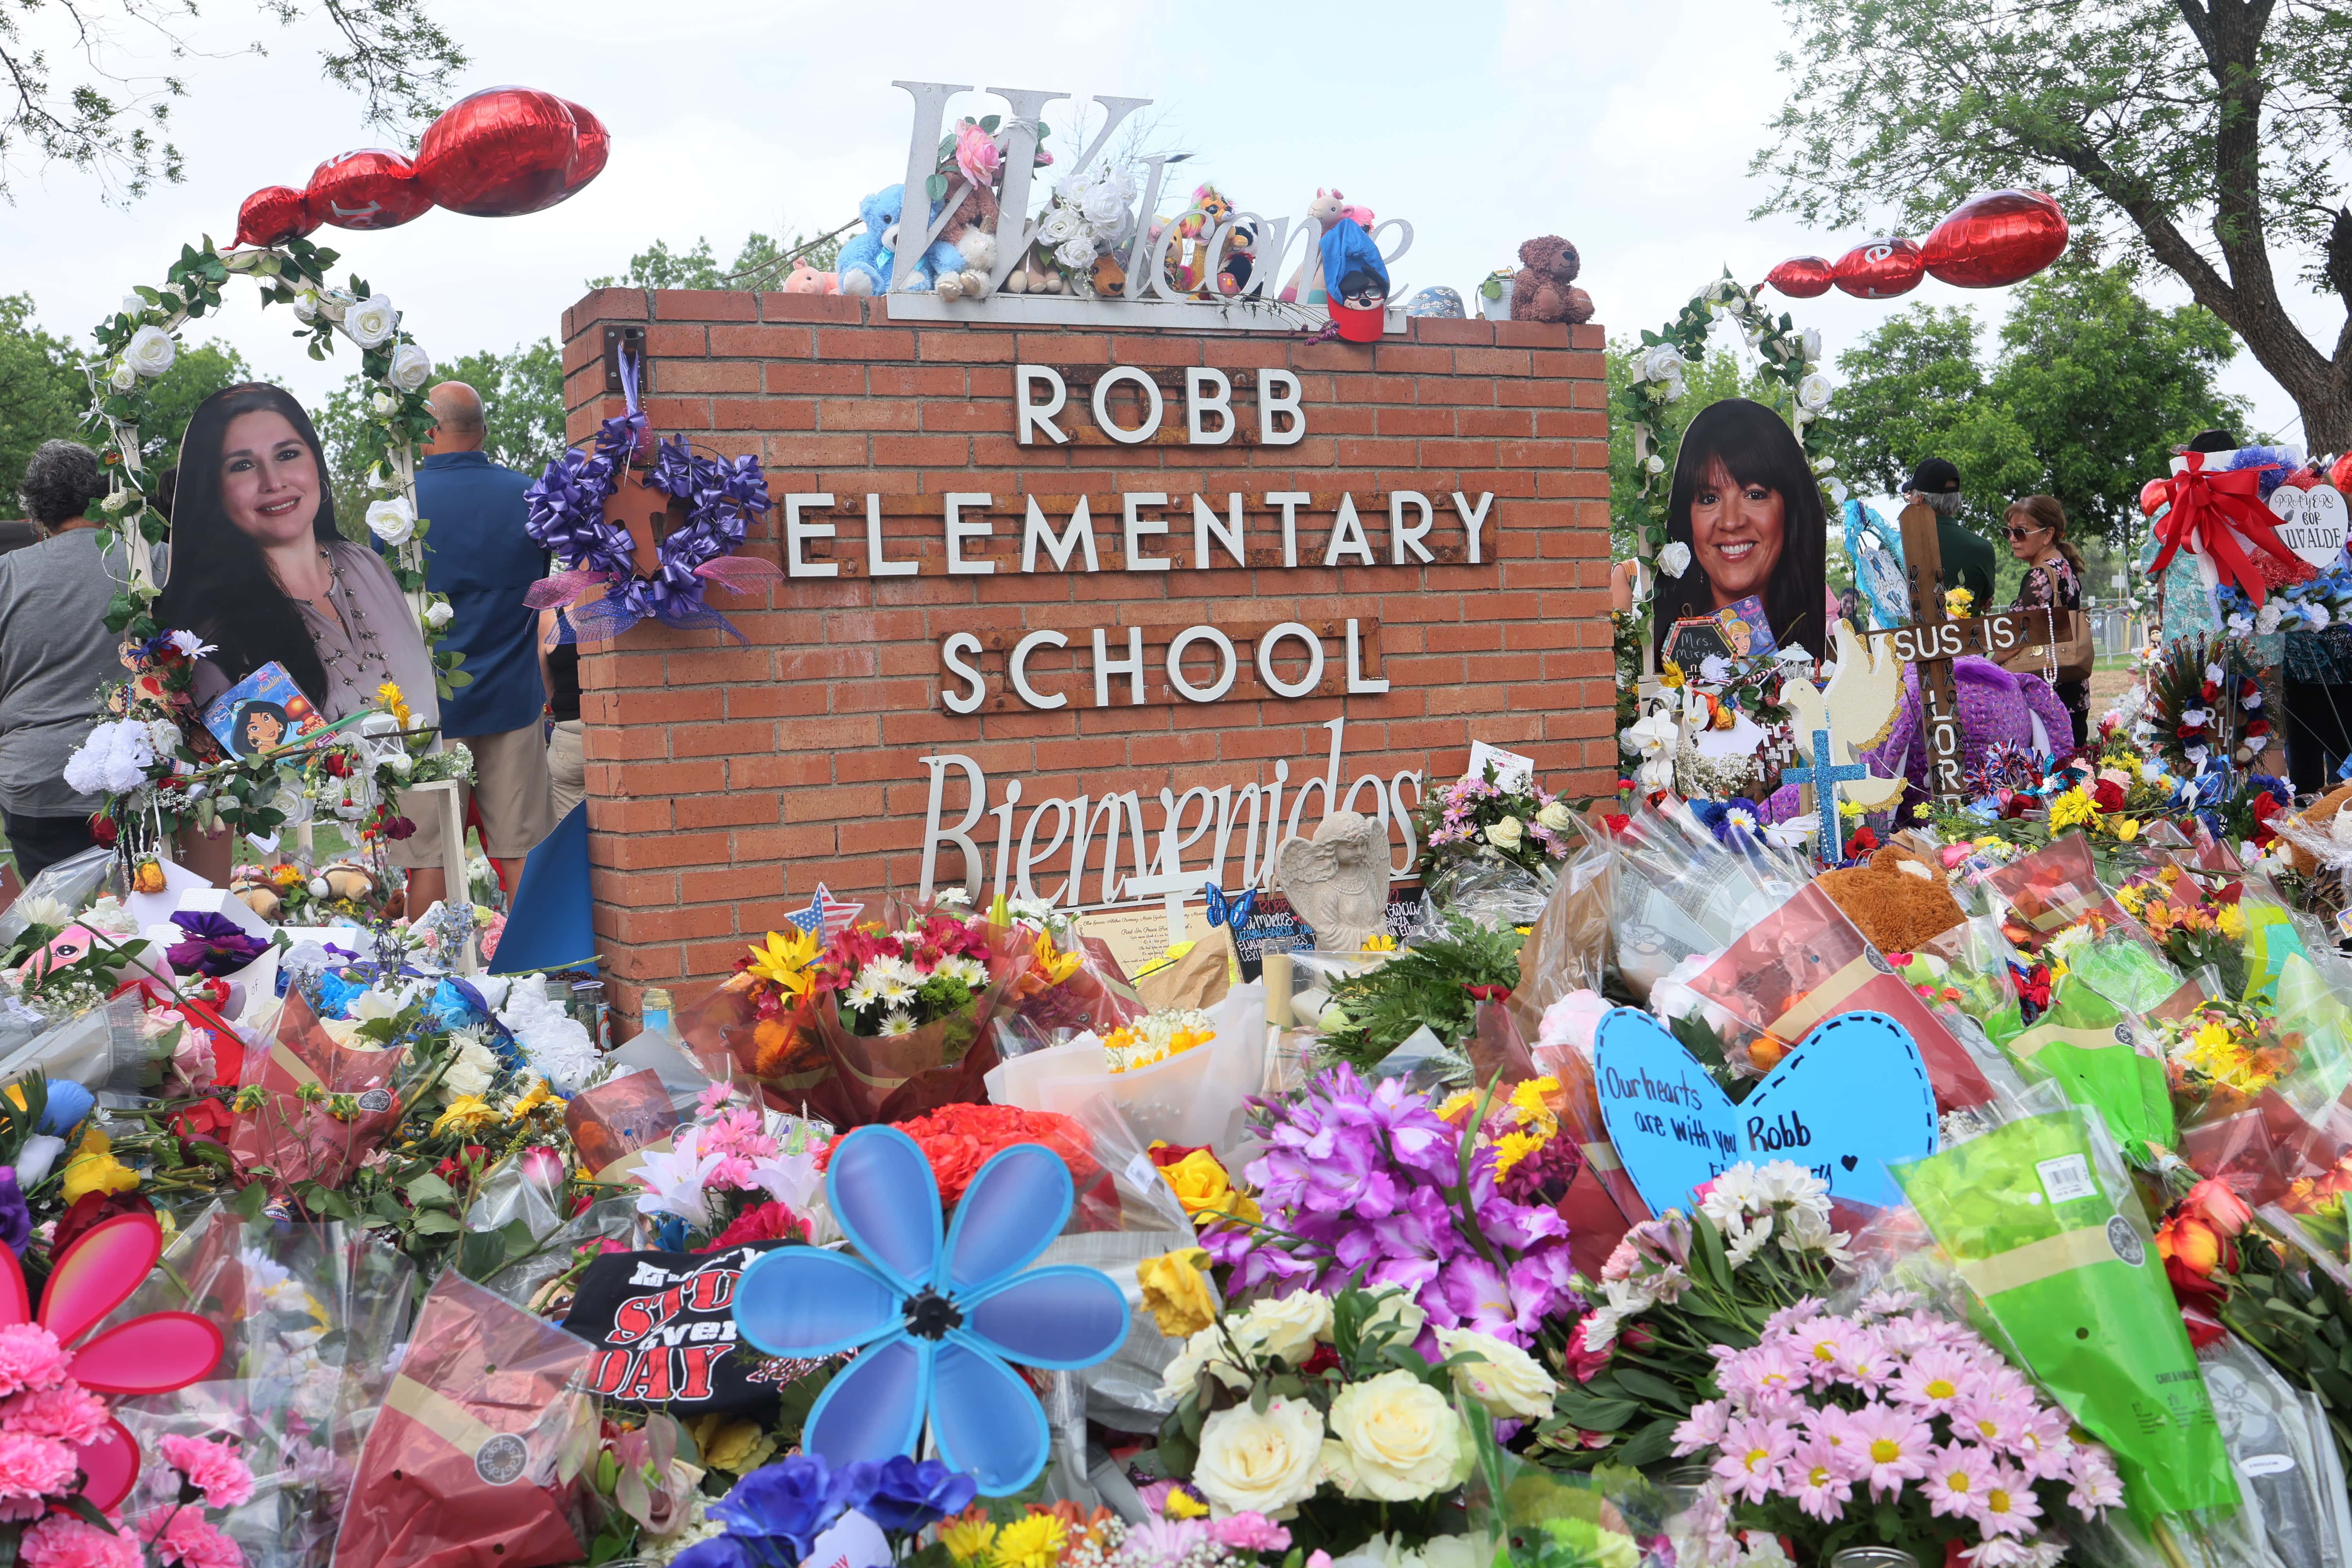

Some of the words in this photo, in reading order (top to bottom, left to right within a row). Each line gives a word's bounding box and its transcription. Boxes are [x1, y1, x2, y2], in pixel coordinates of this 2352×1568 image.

[892, 81, 1414, 303] Wlcome
[1017, 365, 1305, 445] ROBB
[786, 490, 1494, 577] ELEMENTARY
[2285, 528, 2343, 549] UVALDE
[1681, 632, 1712, 649] Mrs.
[1870, 624, 1962, 661] SUS
[1984, 617, 2015, 651] IS
[256, 675, 283, 699] Aladdin
[941, 618, 1390, 715] SCHOOL
[1259, 898, 1290, 914] ROBB
[1386, 901, 1423, 917] Garcia
[1235, 928, 1265, 941] UZIYAH
[1266, 925, 1294, 938] GARCIA
[251, 978, 258, 995] of
[1640, 1067, 1702, 1111] hearts
[1634, 1111, 1666, 1137] are
[1670, 1116, 1711, 1150] with
[1712, 1130, 1738, 1160] you
[1747, 1110, 1811, 1152] Robb
[564, 1343, 736, 1401] DAY
